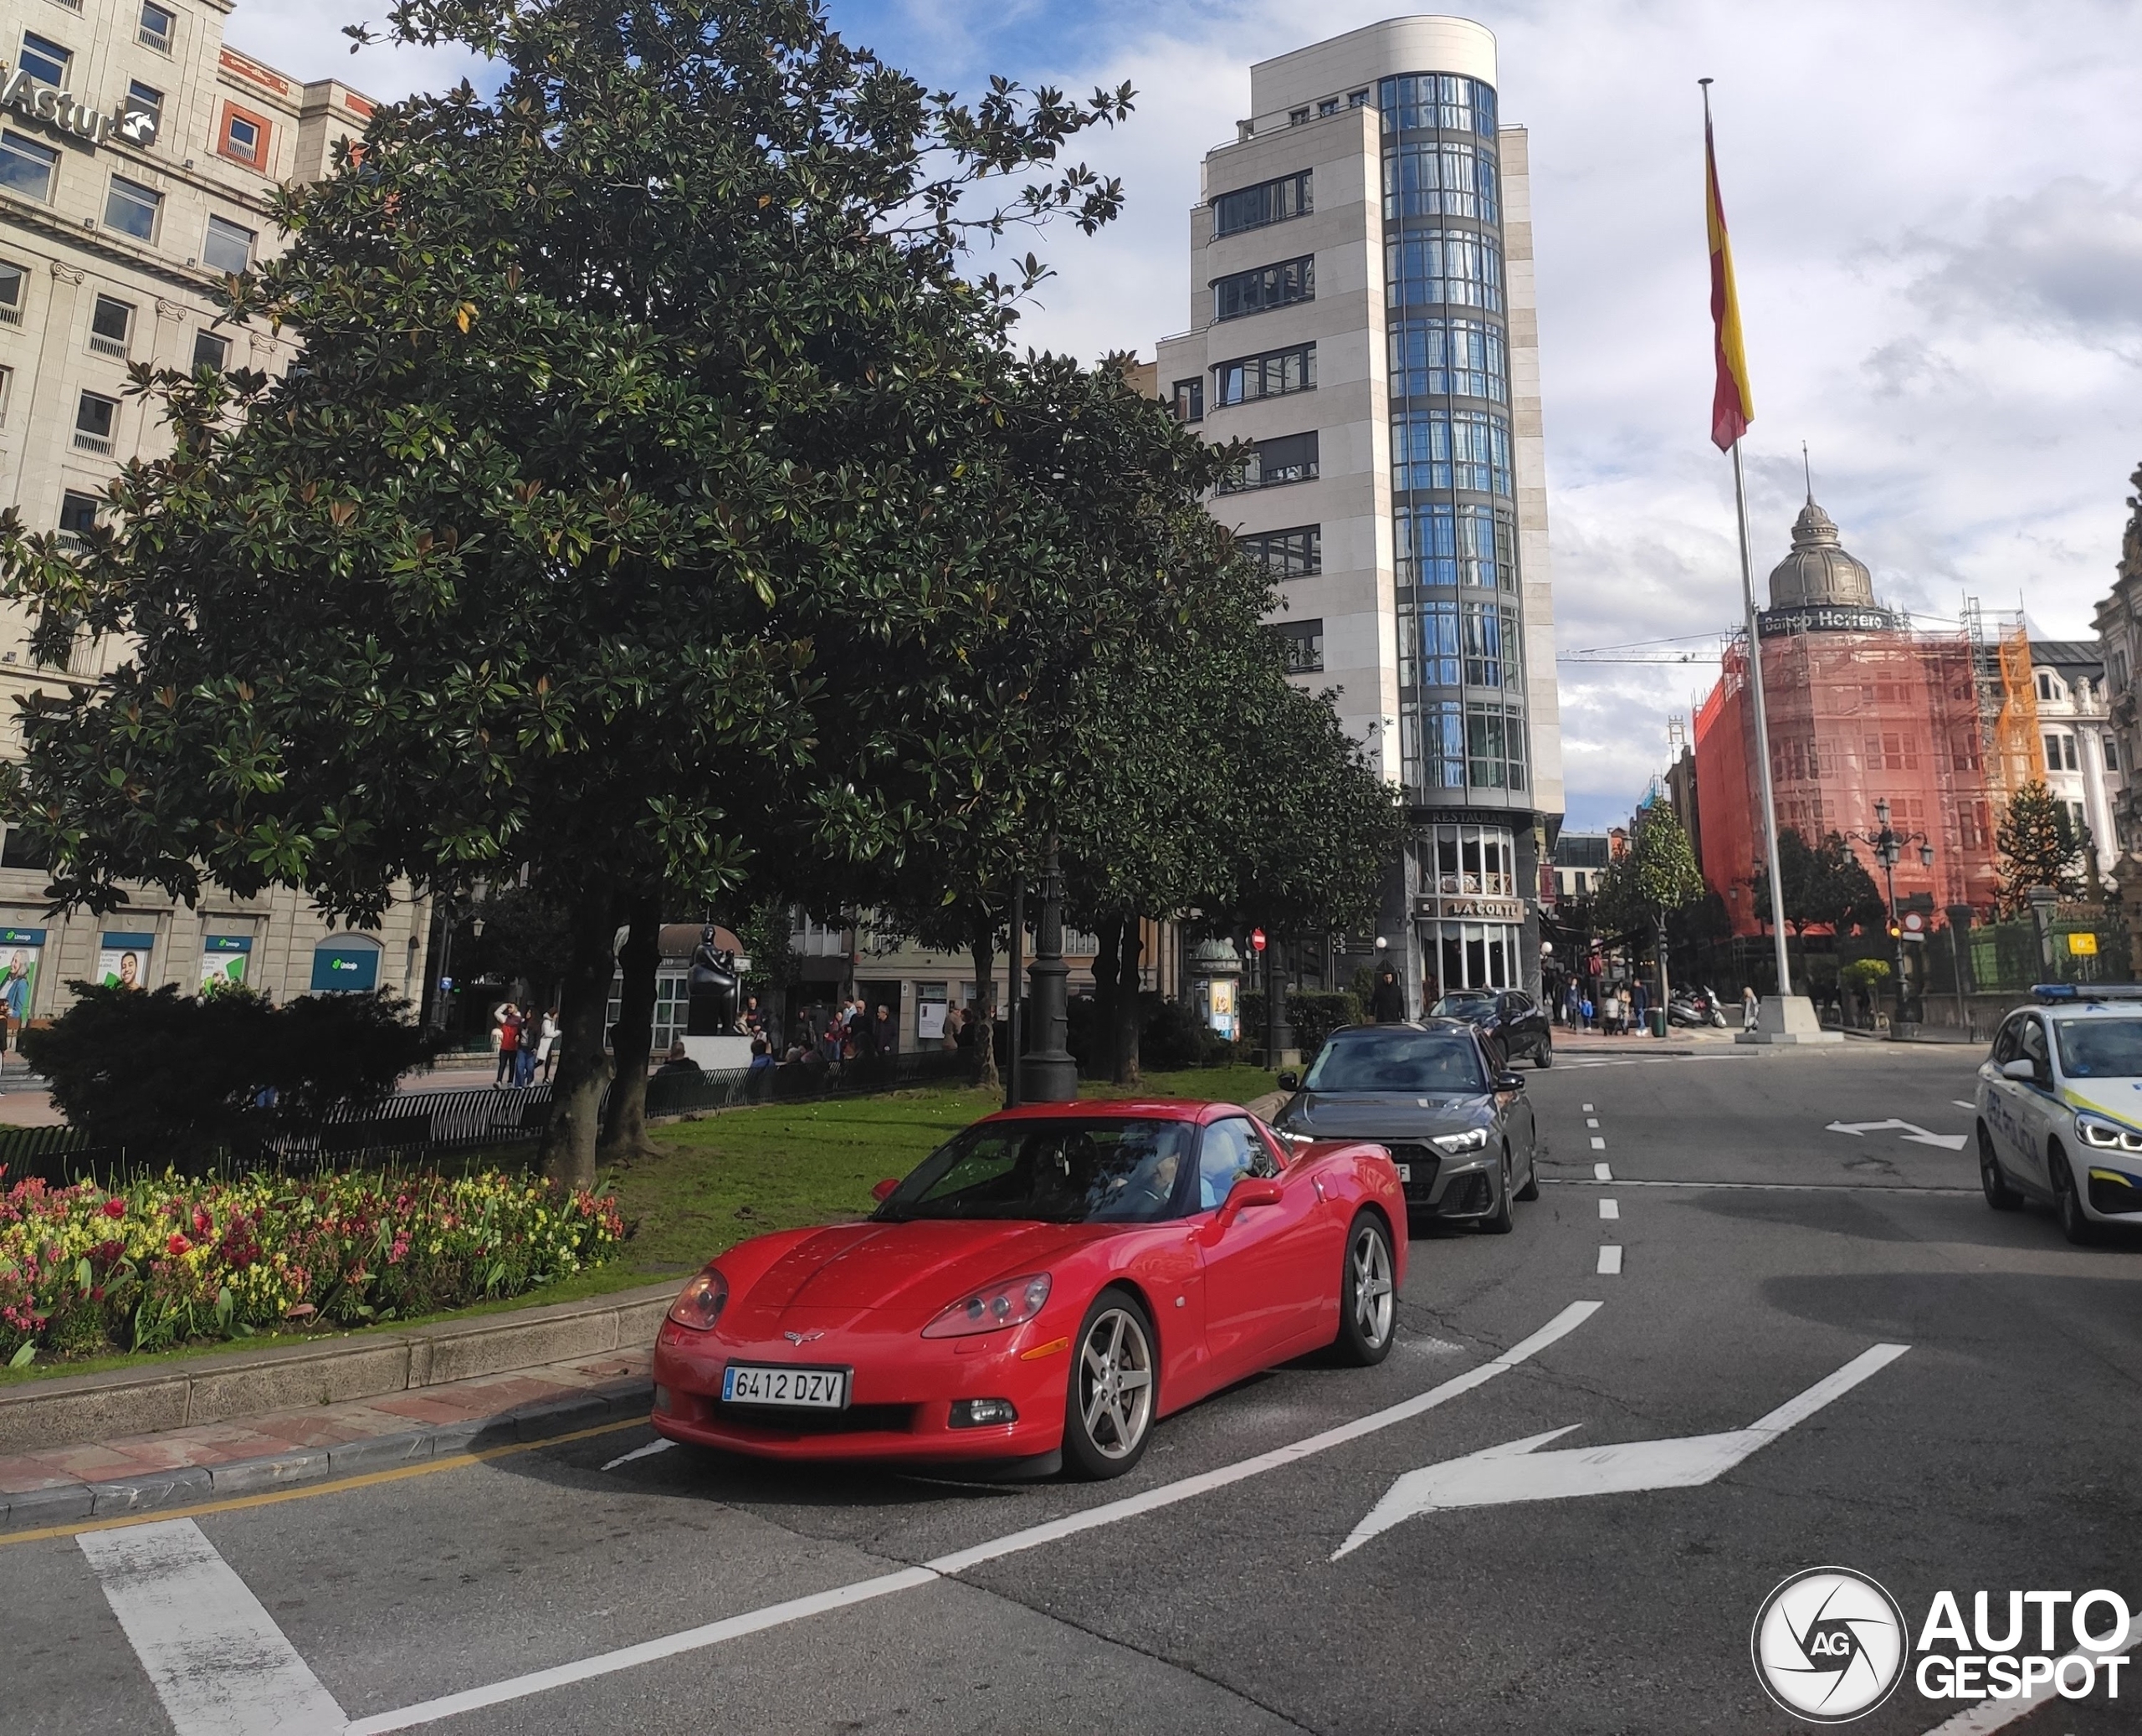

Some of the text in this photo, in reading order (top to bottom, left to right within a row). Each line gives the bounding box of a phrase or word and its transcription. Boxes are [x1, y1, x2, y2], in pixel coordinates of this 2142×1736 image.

[1819, 611, 1882, 629] Herrero
[1453, 902, 1517, 916] LA CORTE
[736, 1372, 837, 1401] 6412 DZV
